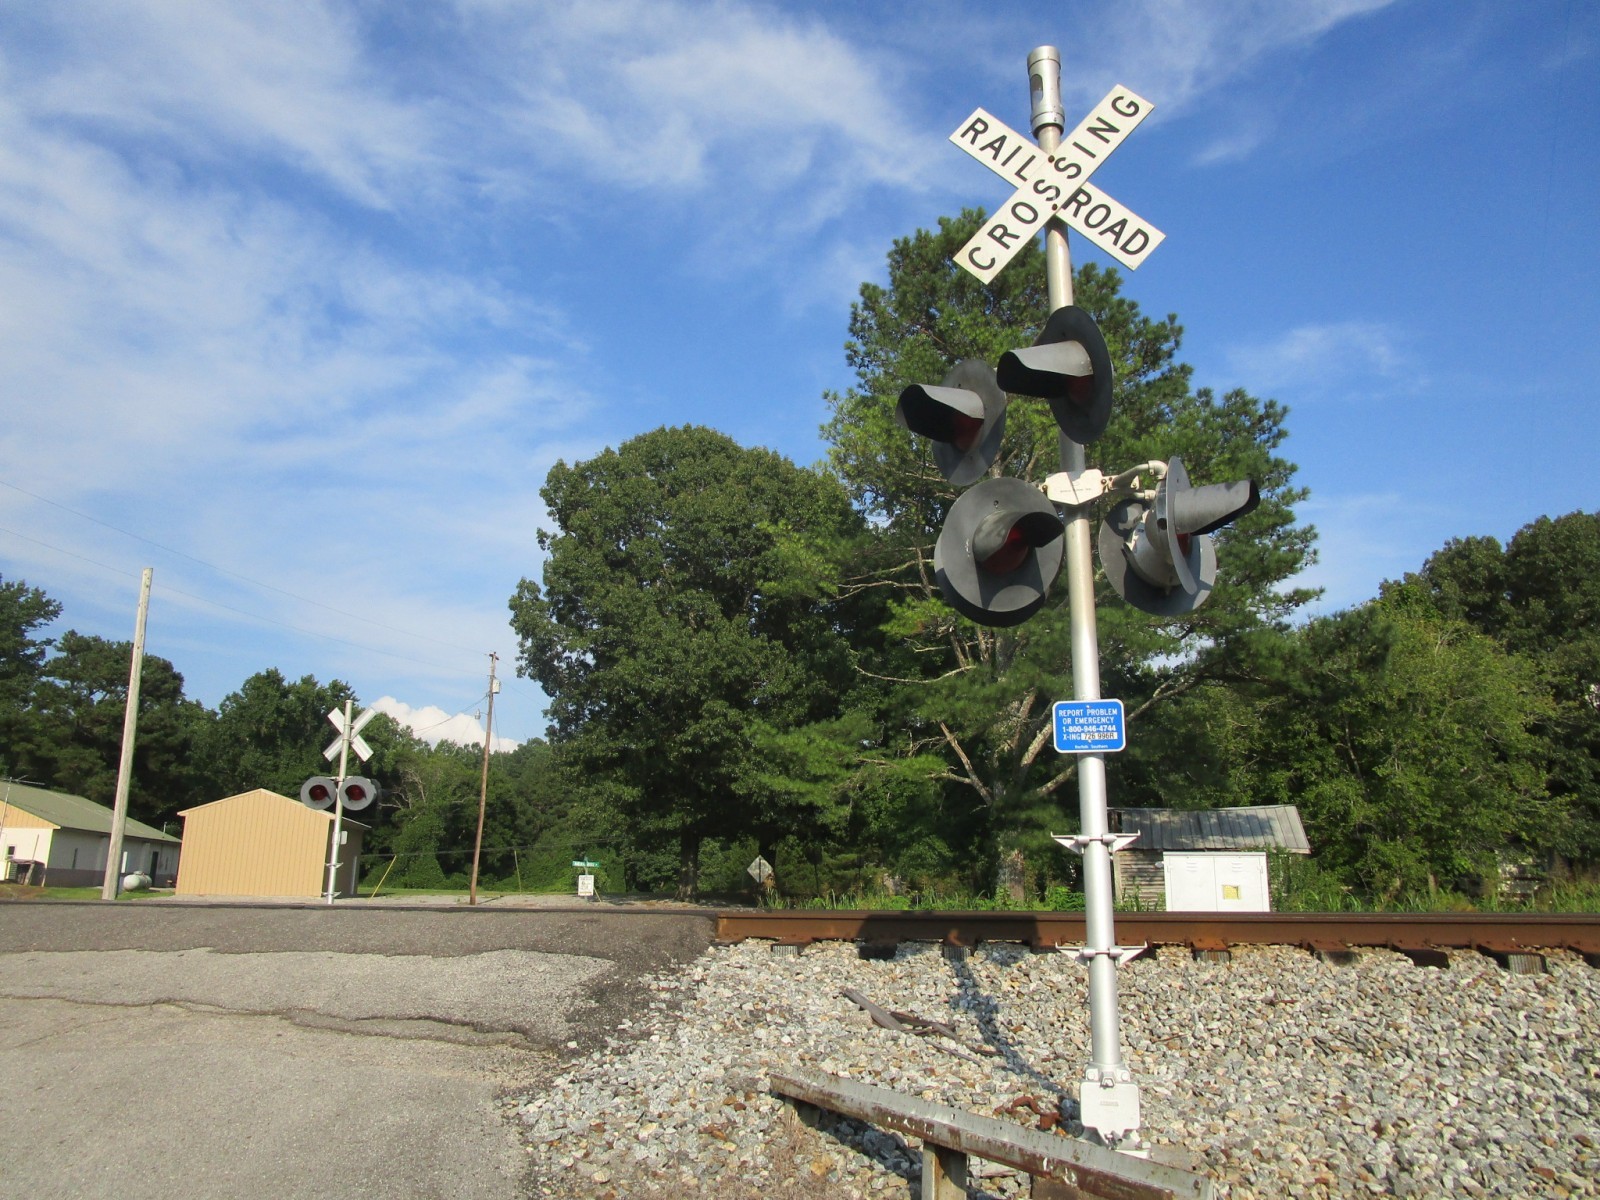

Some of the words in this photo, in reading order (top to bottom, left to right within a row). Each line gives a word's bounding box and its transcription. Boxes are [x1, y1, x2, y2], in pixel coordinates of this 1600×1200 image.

[960, 117, 1036, 182] RAIL
[968, 95, 1140, 271] CROSSING
[1061, 187, 1149, 256] ROAD
[1058, 709, 1083, 717] REPORT
[1087, 708, 1118, 716] PROBLEM
[1062, 717, 1072, 725] OR
[1075, 716, 1114, 725] EMERGENCY
[1062, 725, 1117, 733] 1-800-946-4744
[1063, 733, 1081, 741] X-ING
